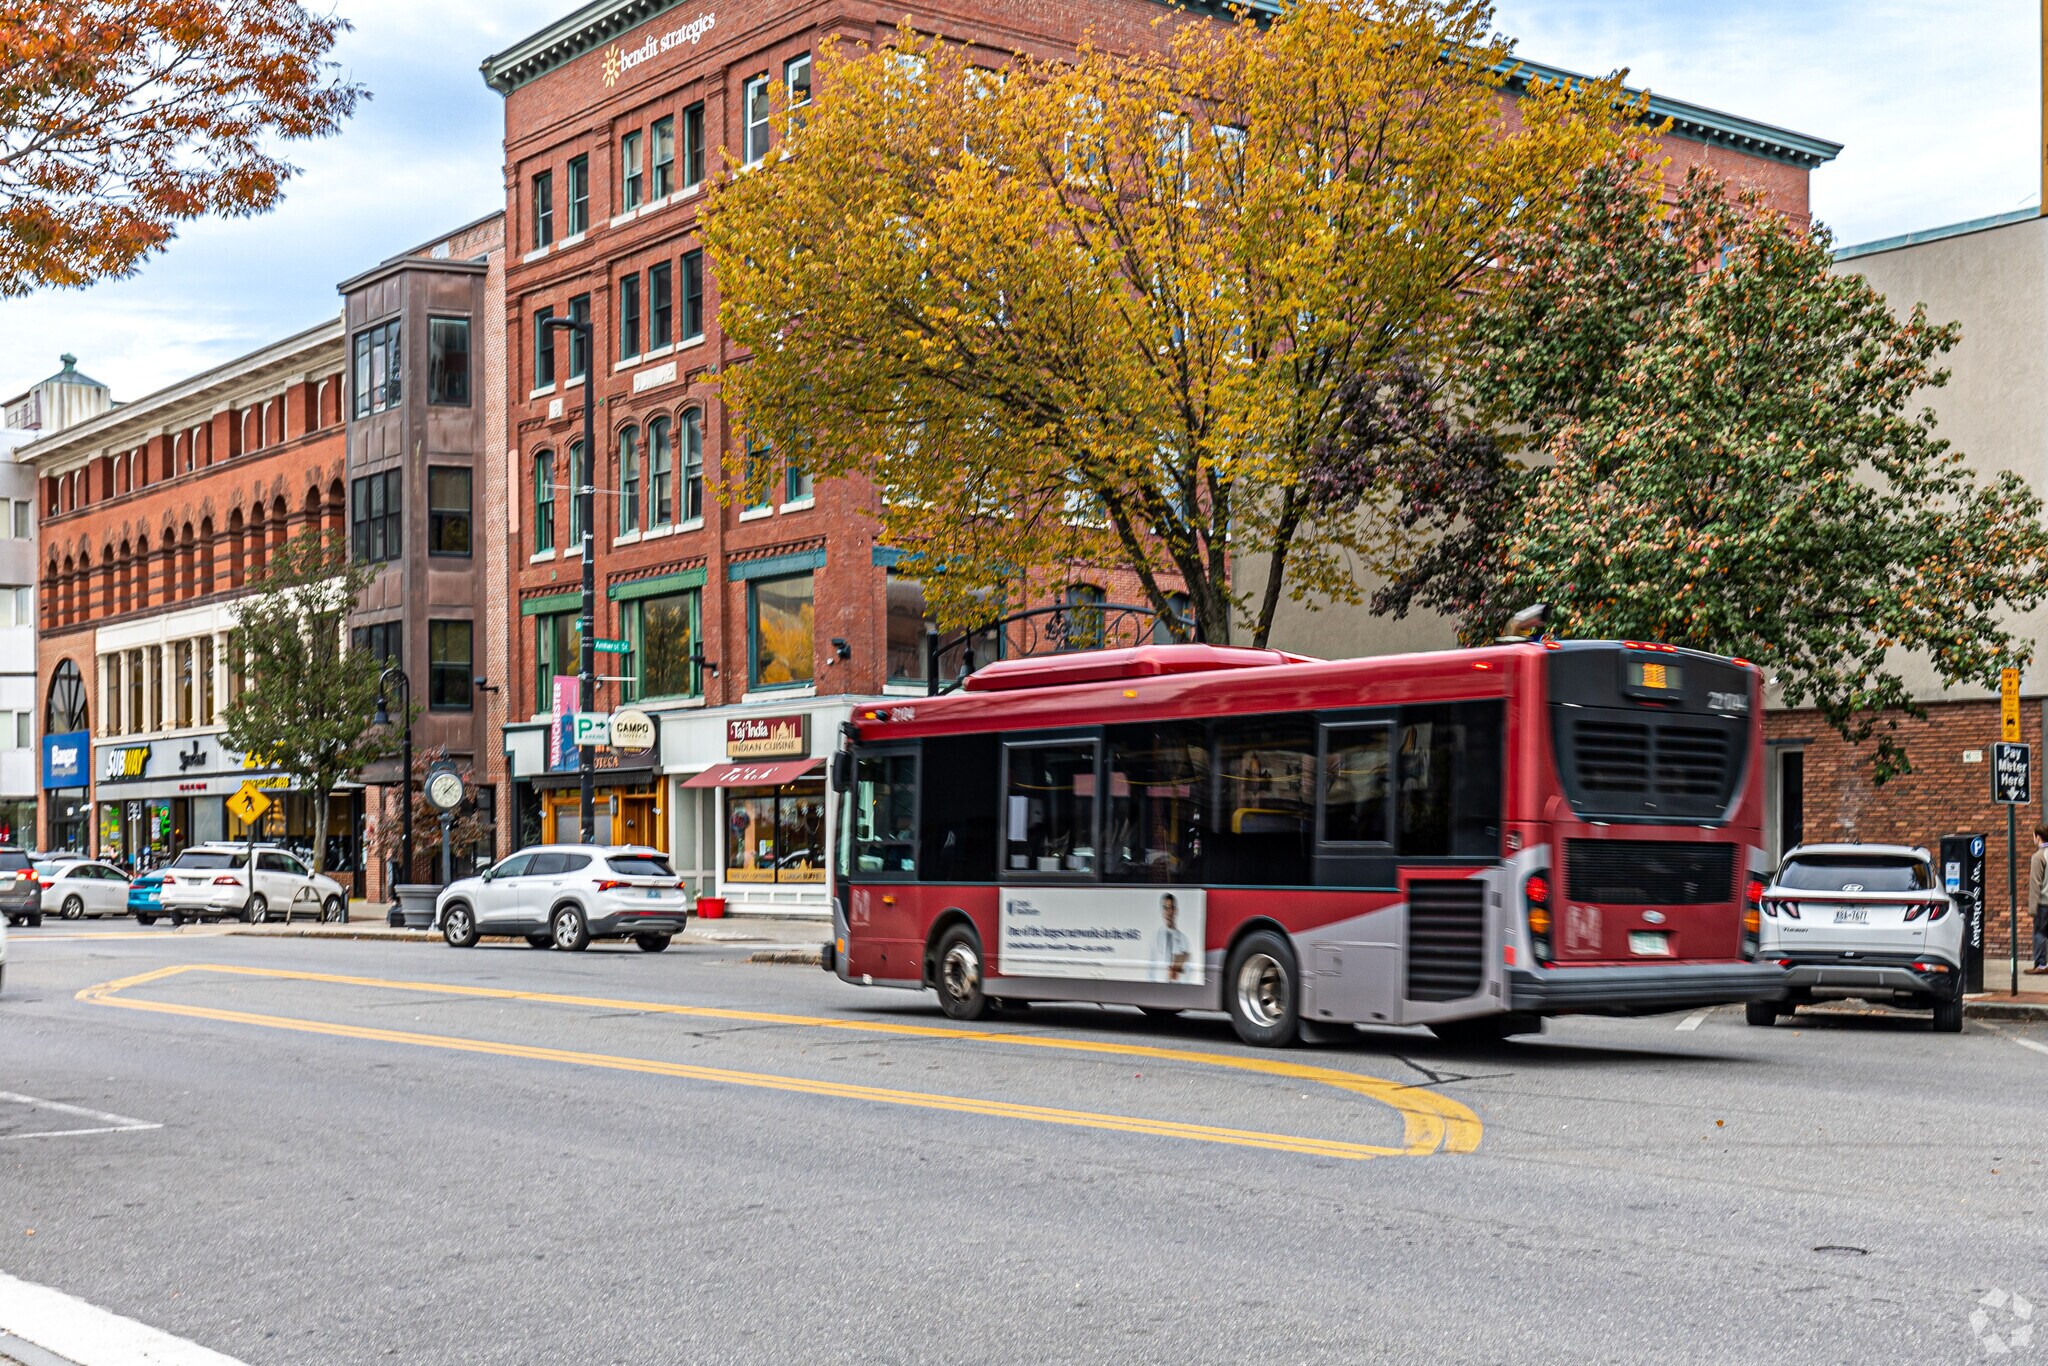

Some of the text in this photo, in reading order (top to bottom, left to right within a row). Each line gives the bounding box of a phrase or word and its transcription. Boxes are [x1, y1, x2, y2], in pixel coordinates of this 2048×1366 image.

[620, 12, 716, 72] benefit strategies
[594, 641, 628, 651] Amherst St
[550, 682, 561, 767] MANCHESTER
[617, 723, 648, 734] CAMPO
[731, 720, 769, 743] Taj India
[732, 740, 796, 753] INDIAN CUISINE
[2003, 745, 2022, 763] Pay
[105, 747, 149, 777] SUBWAY
[1998, 759, 2028, 773] Meter
[2001, 773, 2025, 787] Here
[1970, 900, 1982, 949] Display
